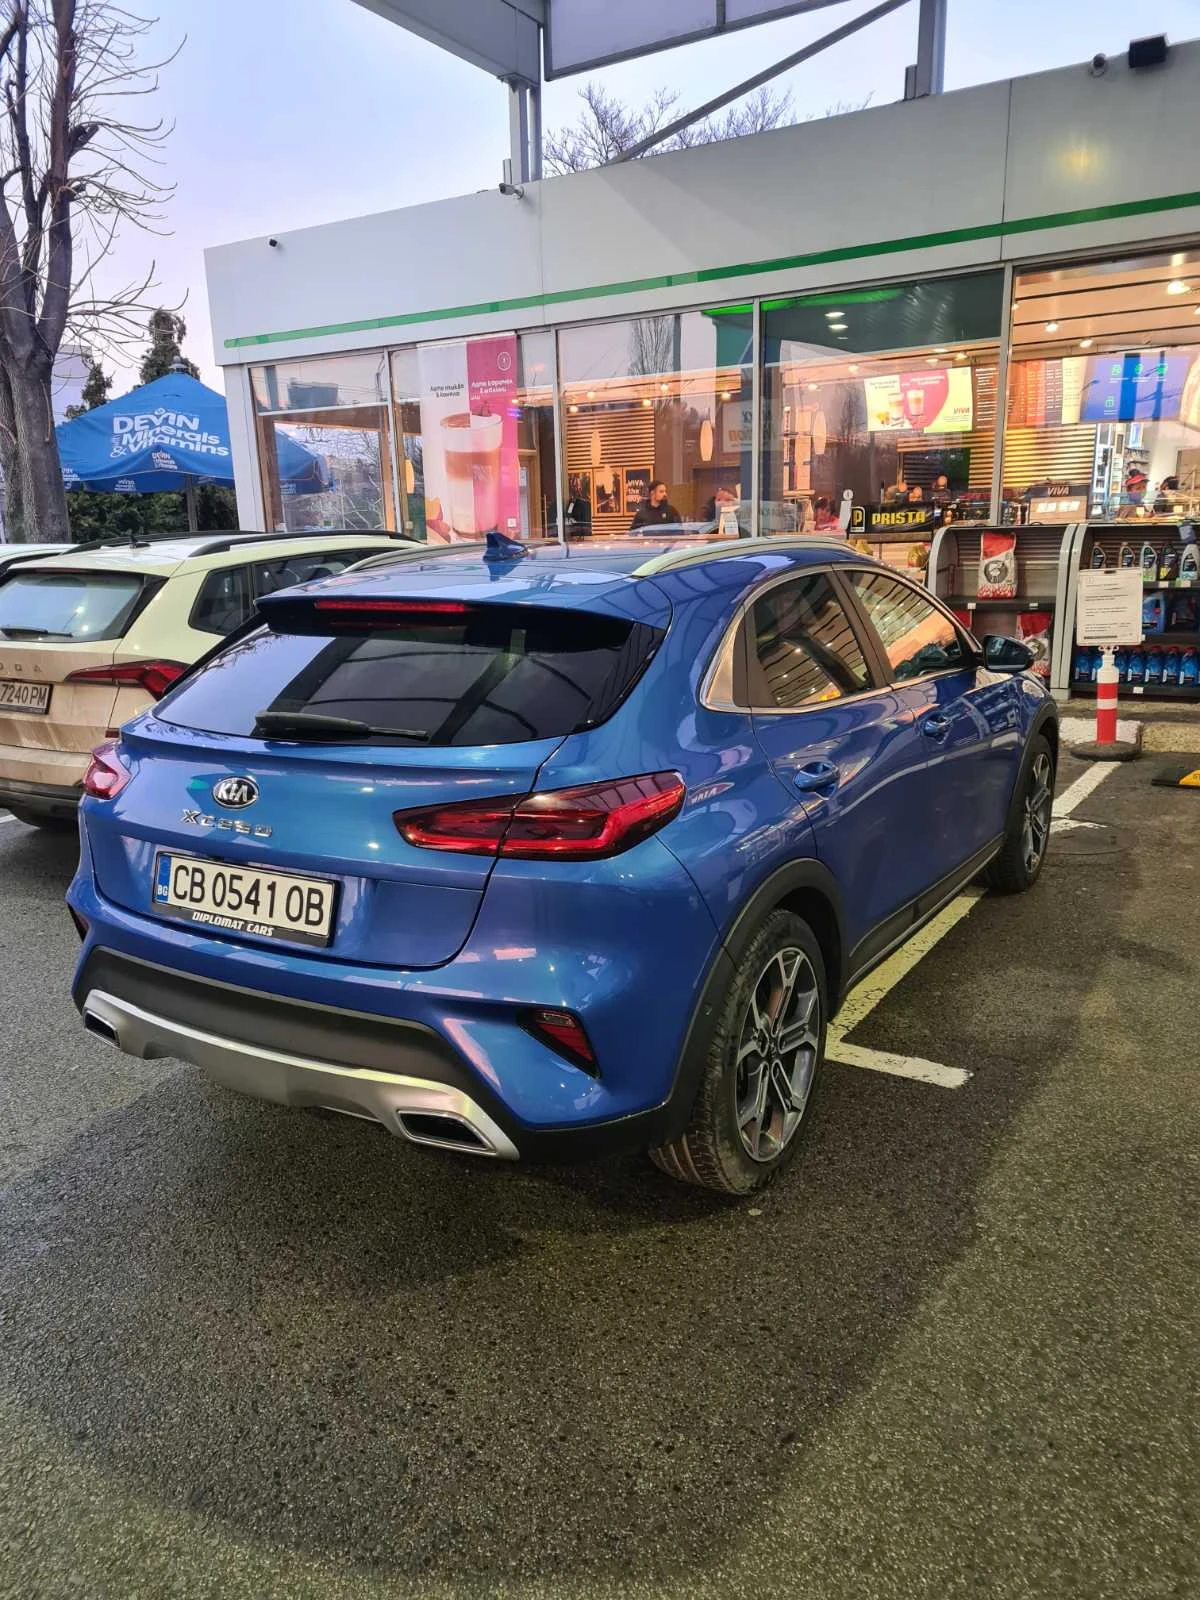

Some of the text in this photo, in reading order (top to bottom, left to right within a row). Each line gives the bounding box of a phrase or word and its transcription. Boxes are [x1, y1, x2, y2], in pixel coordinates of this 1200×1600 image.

[113, 411, 200, 434] DEVIN
[122, 425, 220, 446] Minerals
[128, 433, 230, 456] Vitamins
[1047, 486, 1069, 496] VIVA
[871, 511, 926, 525] PRISTA
[0, 683, 48, 706] 7240 PM
[157, 884, 169, 896] BG
[173, 864, 324, 926] CB 0541 OB
[191, 911, 275, 937] DIPLOMAT CARS
